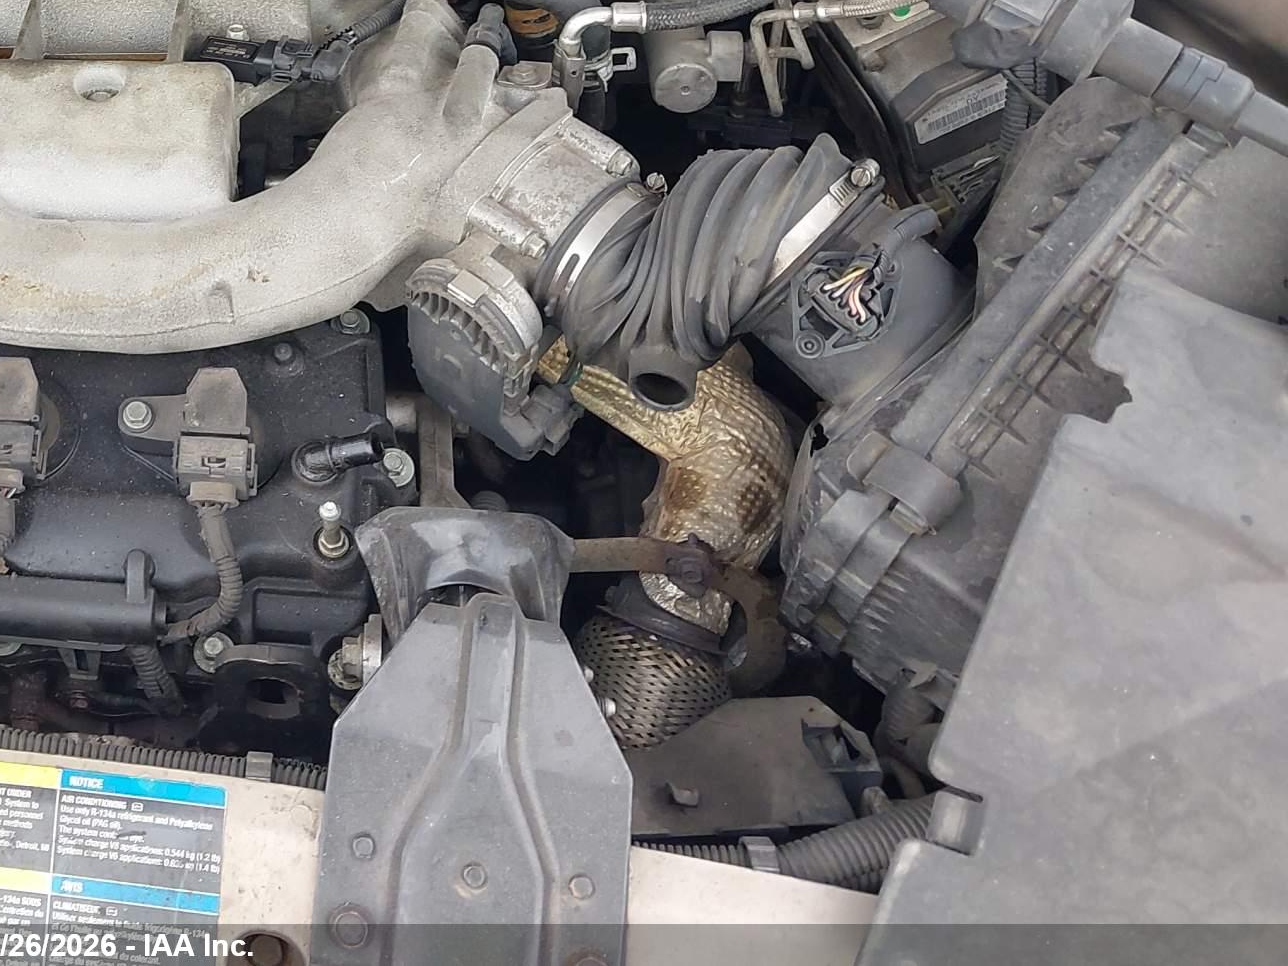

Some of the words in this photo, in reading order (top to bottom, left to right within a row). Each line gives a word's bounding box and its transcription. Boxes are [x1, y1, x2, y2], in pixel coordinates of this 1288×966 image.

[69, 776, 104, 789] NOTICE
[61, 795, 74, 804] AIR
[75, 796, 128, 809] CONDITIONING
[60, 805, 73, 814] Use
[74, 807, 90, 817] only
[154, 816, 168, 824] and
[58, 825, 72, 833] The
[165, 847, 185, 857] 0.544
[60, 880, 83, 892] AVIS
